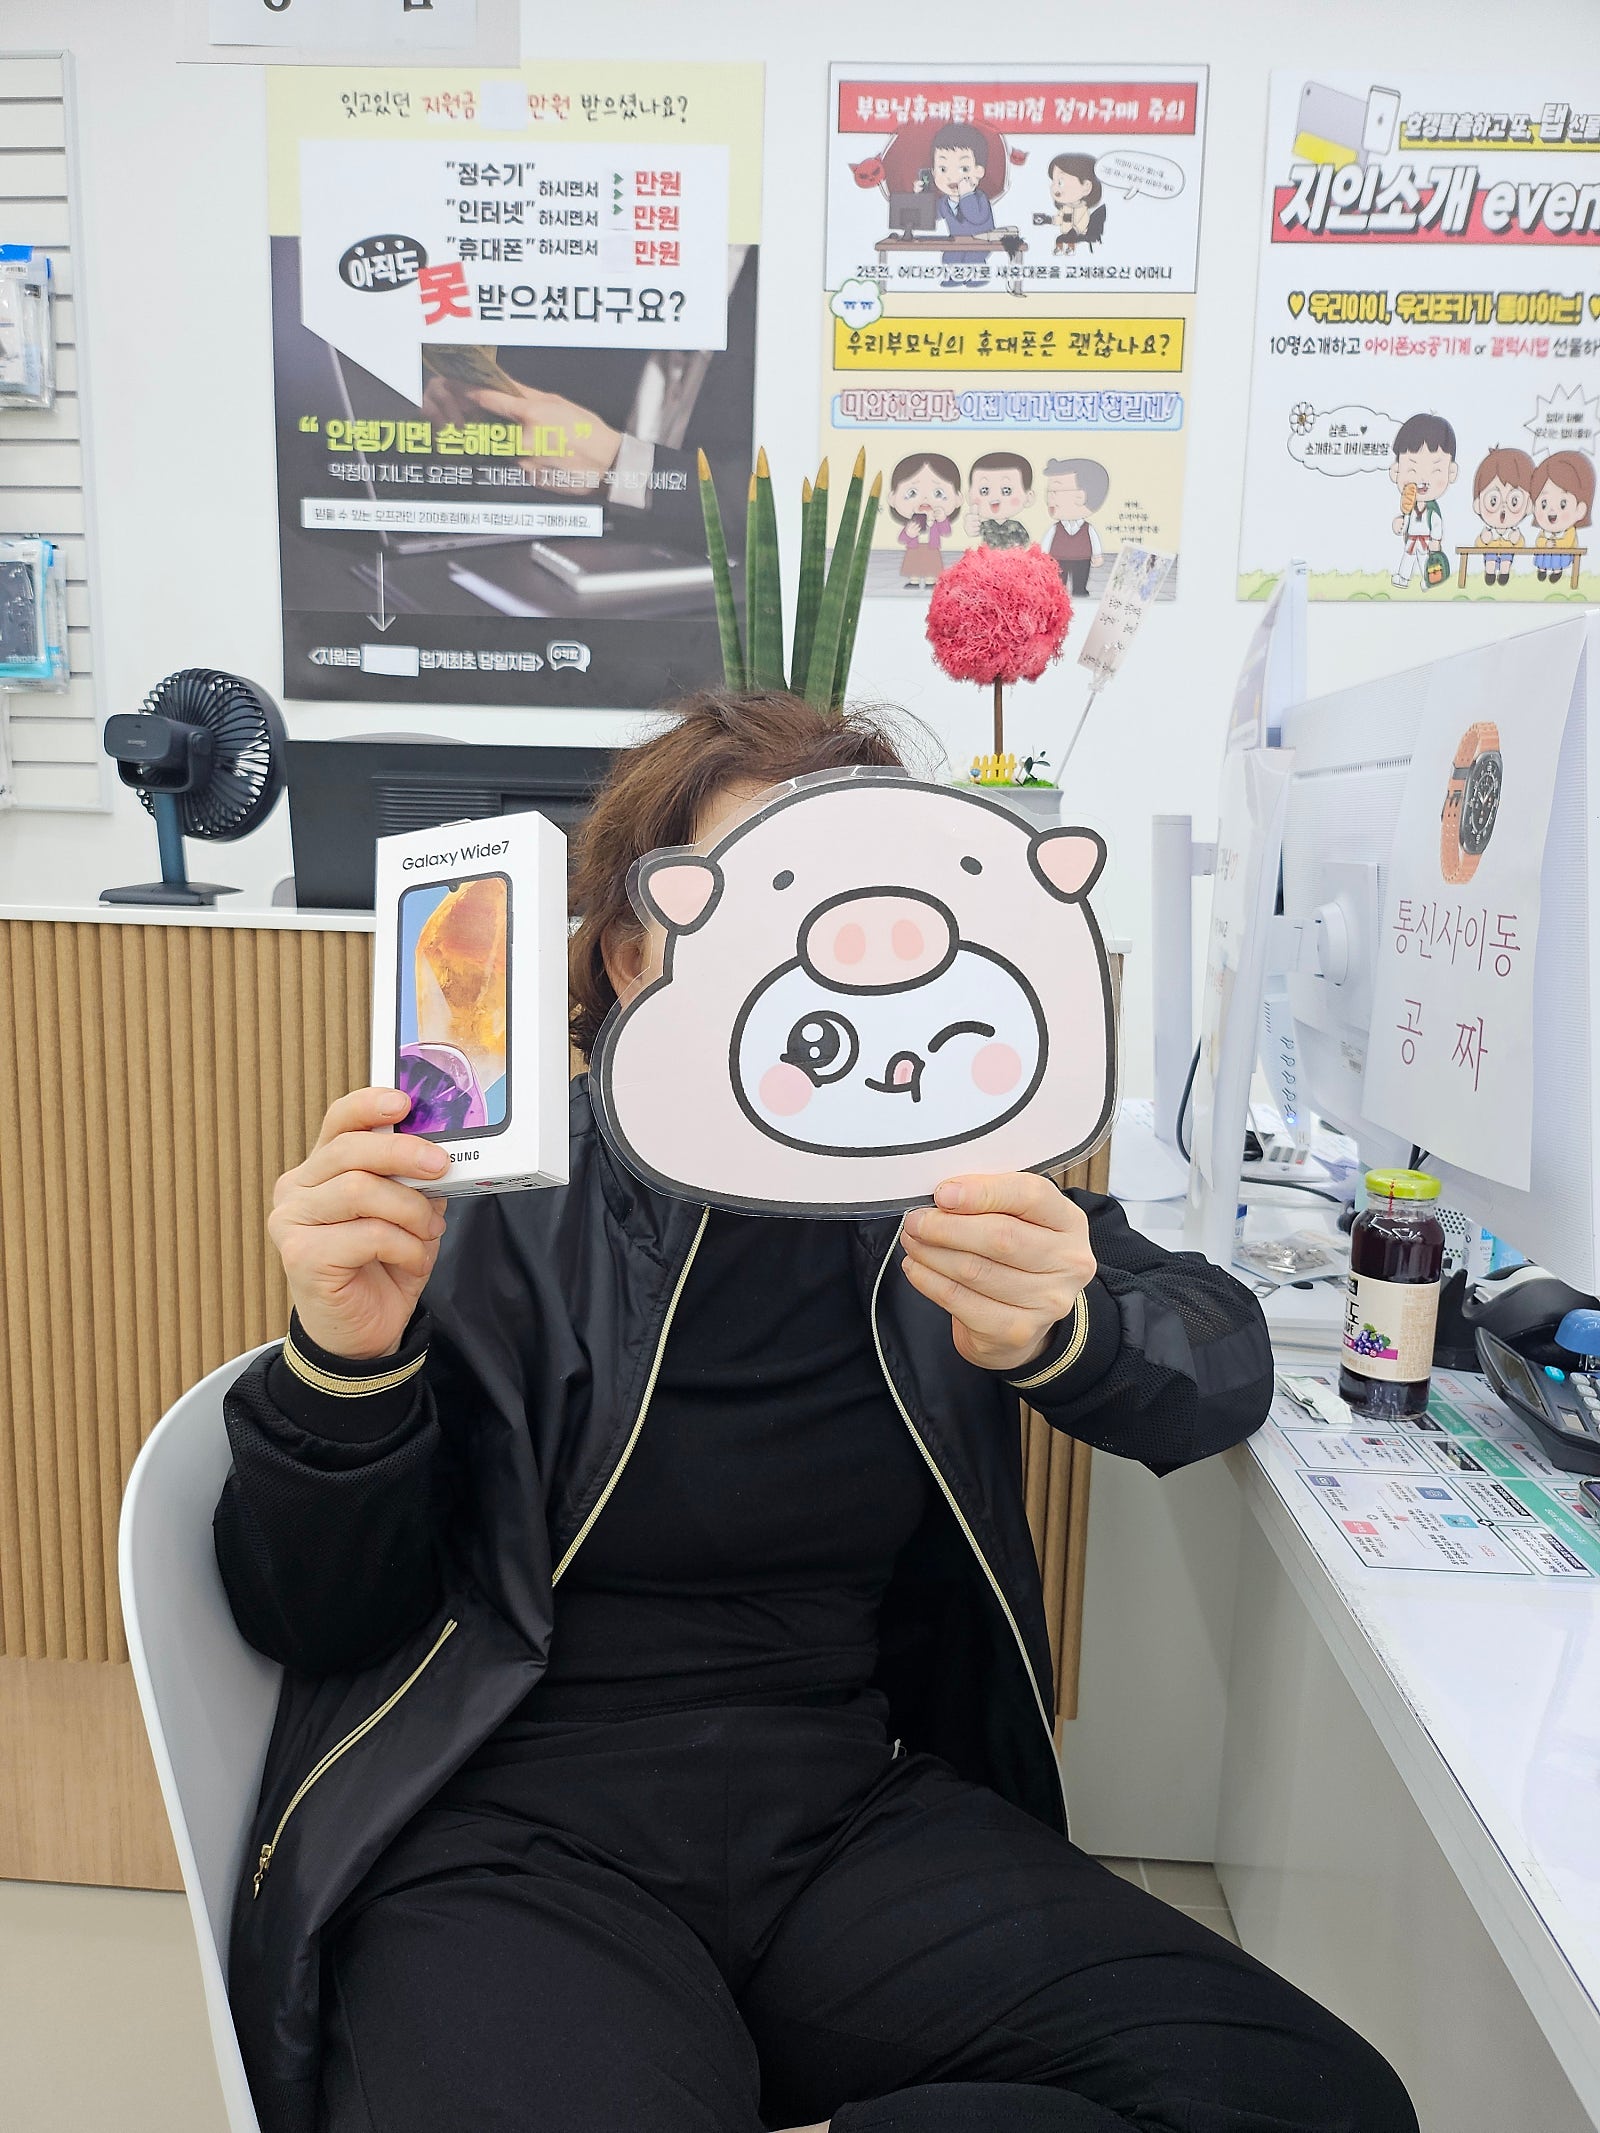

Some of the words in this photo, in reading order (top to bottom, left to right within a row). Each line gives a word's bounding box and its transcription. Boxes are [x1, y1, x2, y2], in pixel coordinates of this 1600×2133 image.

[341, 92, 411, 118] 잊고있던
[422, 94, 476, 119] 지원금
[528, 94, 570, 119] 만원
[581, 94, 688, 123] 받으셨나요?
[856, 95, 976, 122] 부모님휴대폰!
[983, 97, 1046, 123] 대리점
[1054, 97, 1139, 122] 정가구매
[1148, 98, 1186, 122] 주의
[1404, 112, 1511, 142] 호갱탈출하고
[1538, 103, 1573, 144] 탭
[538, 181, 599, 198] 하시면서
[634, 171, 682, 198] 만원
[1279, 163, 1479, 236] 지인소개
[538, 209, 599, 228] 하시면서
[633, 205, 681, 231] 만원
[538, 238, 599, 257] 하시면서
[633, 240, 681, 267] 만원
[347, 250, 420, 289] 아직도
[898, 265, 950, 280] 어디선가
[1065, 265, 1131, 280] 교체해오신
[1134, 265, 1172, 280] 어머니
[417, 262, 472, 325] 못
[478, 283, 687, 324] 받으셨다구요?
[1308, 290, 1393, 325] 우리아이,
[846, 331, 964, 358] 우리부모님의
[977, 330, 1057, 358] 휴대폰은
[1068, 330, 1171, 358] 괜찮나요?
[1270, 336, 1361, 356] 10명소개하고
[1491, 336, 1550, 358] 갤럭시탭
[1052, 391, 1100, 422] 먼저
[378, 463, 424, 484] 지나도
[426, 465, 473, 486] 요금은
[539, 467, 600, 490] 지원금을
[402, 848, 459, 871] Galaxy
[460, 840, 511, 861] Wide7
[1391, 899, 1521, 978] 통신사이동
[1396, 998, 1424, 1066] 공
[449, 1150, 480, 1163] SUNG
